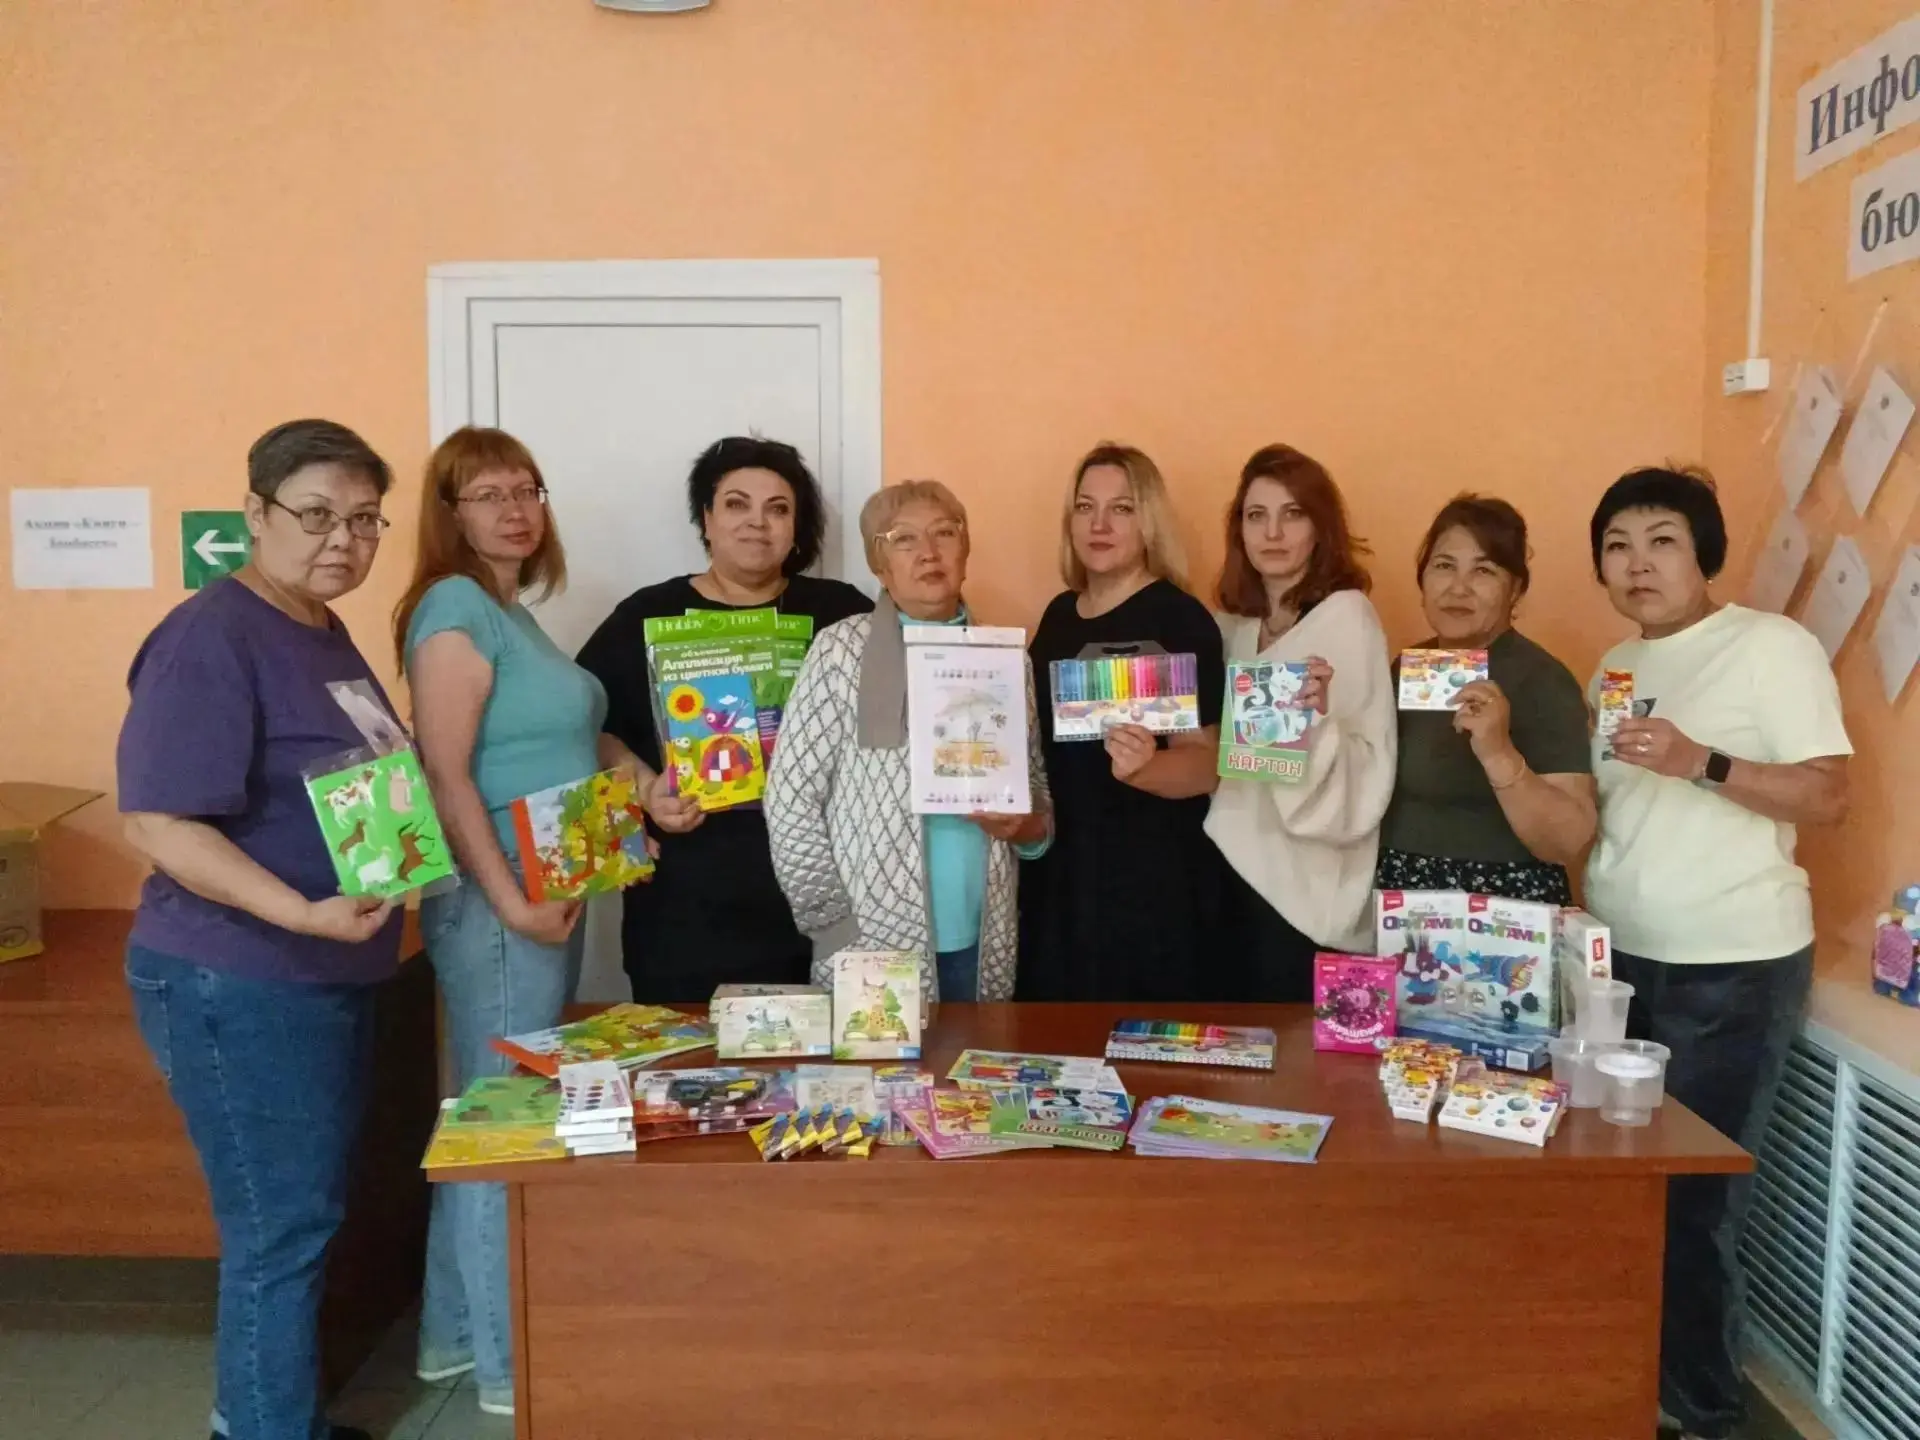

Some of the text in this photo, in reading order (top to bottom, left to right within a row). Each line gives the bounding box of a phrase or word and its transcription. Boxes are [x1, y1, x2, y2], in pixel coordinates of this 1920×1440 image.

[1808, 54, 1920, 155] Инфо
[1861, 188, 1920, 252] бю
[661, 653, 744, 672] Аппликация
[663, 672, 679, 682] из
[680, 667, 730, 682] цветной
[731, 662, 774, 677] бумаги
[1228, 752, 1302, 777] КАРТОН
[1468, 918, 1546, 944] ОРИГАМИ
